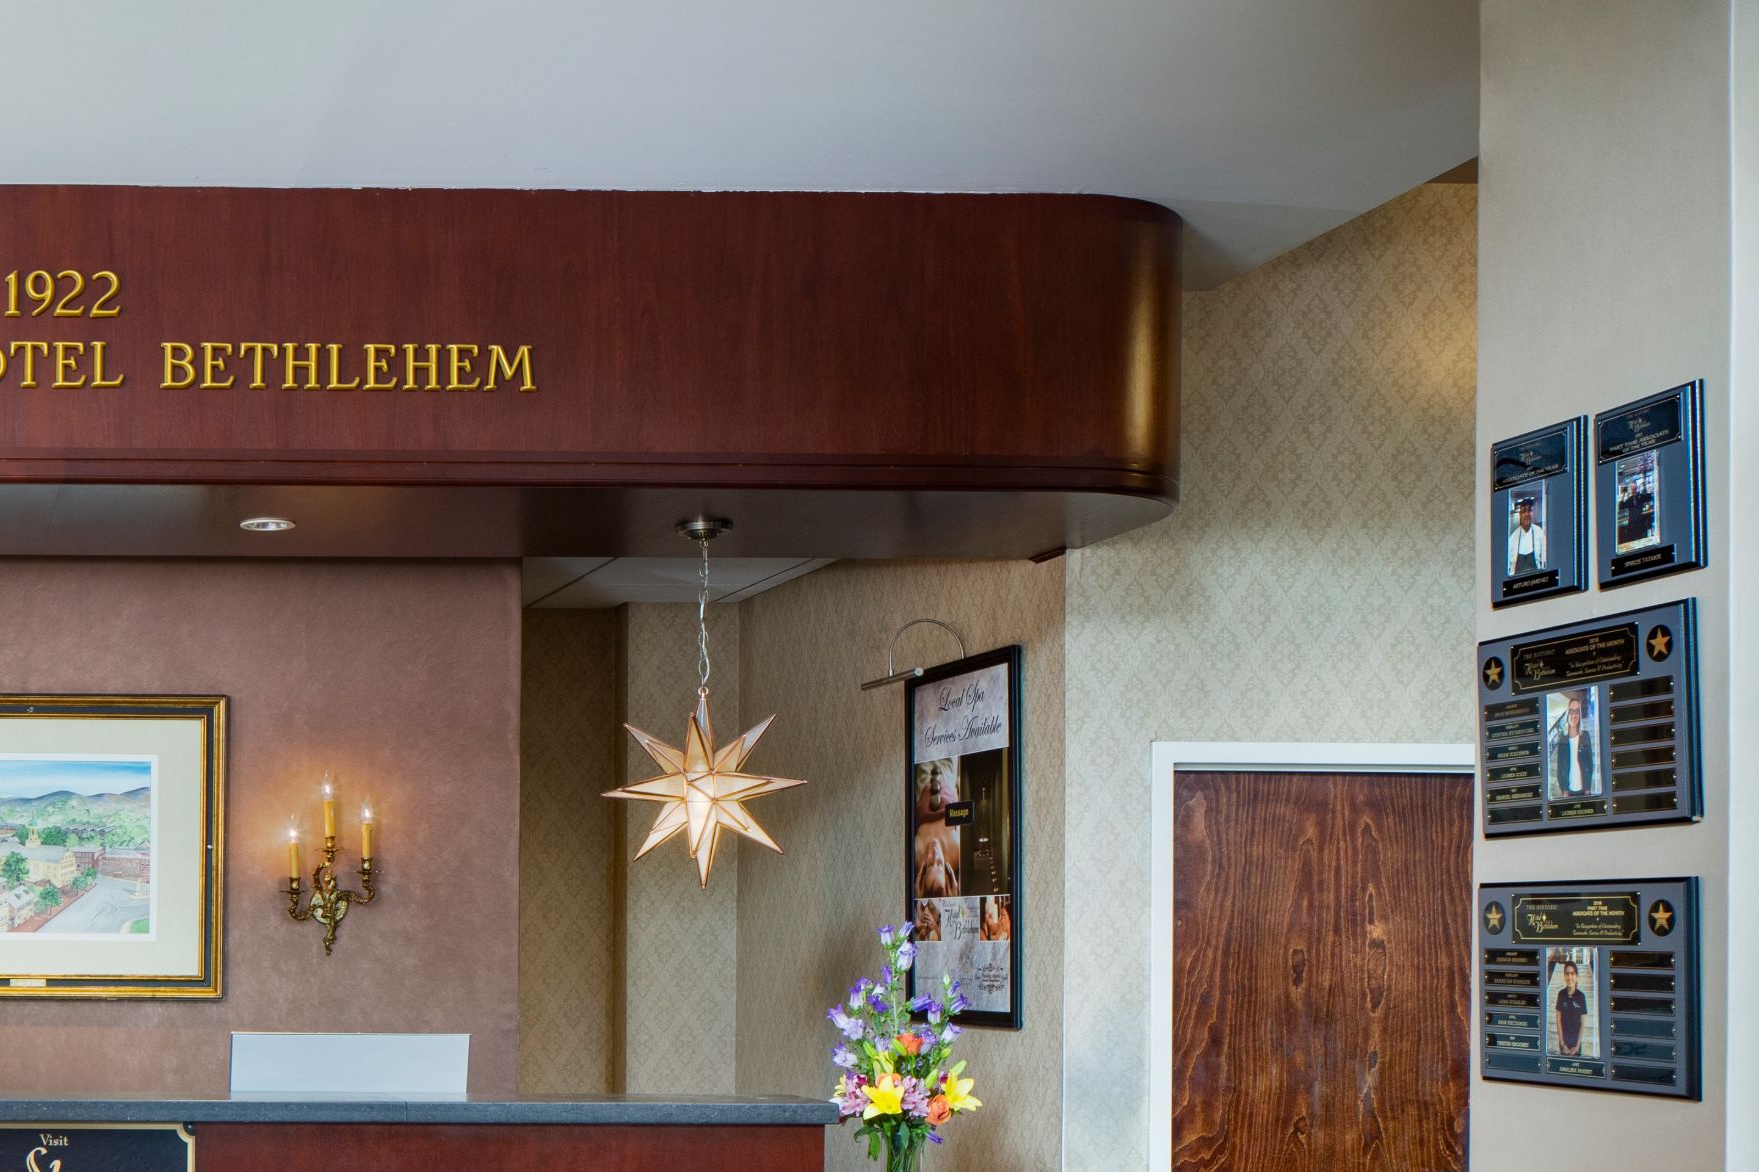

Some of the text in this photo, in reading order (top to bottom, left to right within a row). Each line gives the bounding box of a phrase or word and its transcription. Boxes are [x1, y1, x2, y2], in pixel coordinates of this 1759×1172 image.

[5, 269, 122, 318] 1922
[159, 341, 538, 392] BETHLEHEM
[938, 680, 985, 713] Local Spa
[923, 714, 1002, 749] Services Available
[949, 808, 969, 818] Massage
[38, 1133, 69, 1147] Visit
